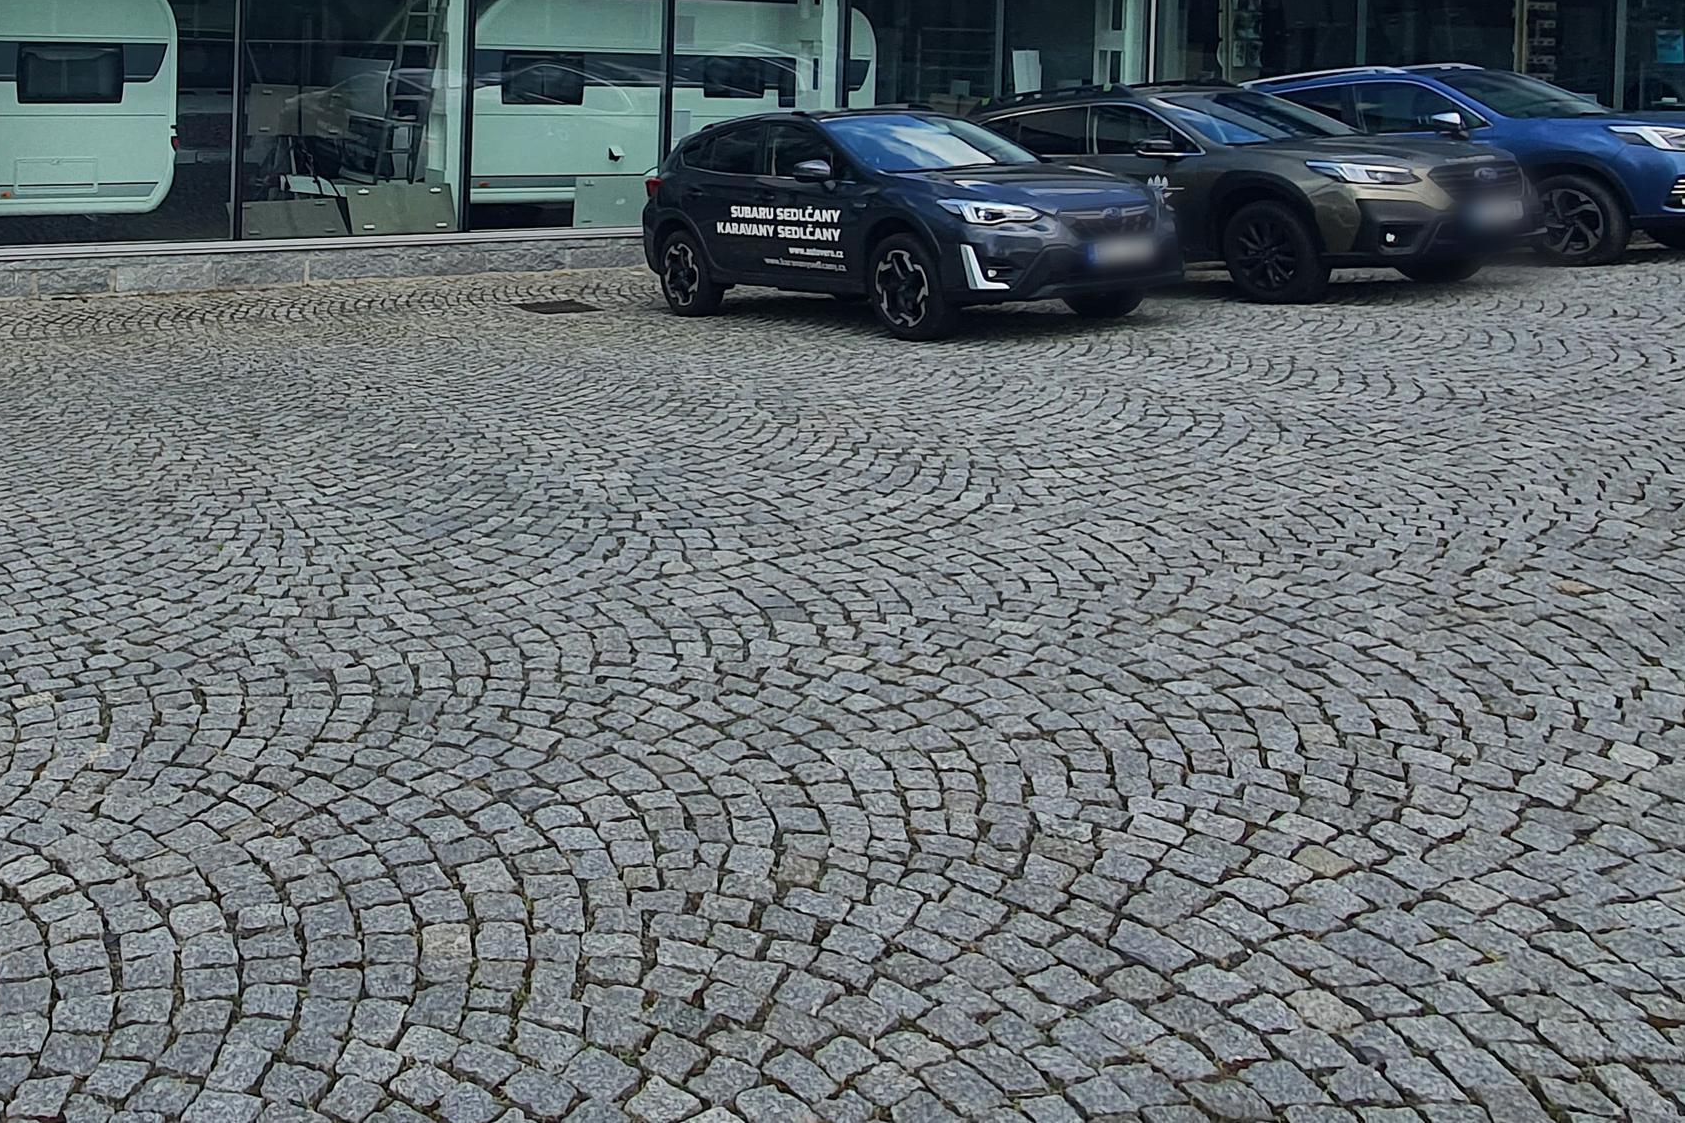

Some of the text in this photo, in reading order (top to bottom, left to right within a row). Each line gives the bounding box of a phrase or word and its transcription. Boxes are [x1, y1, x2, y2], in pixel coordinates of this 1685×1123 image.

[730, 205, 841, 223] SUBARU SEDLČANY
[716, 222, 841, 242] KARAVANY SEDLČANY
